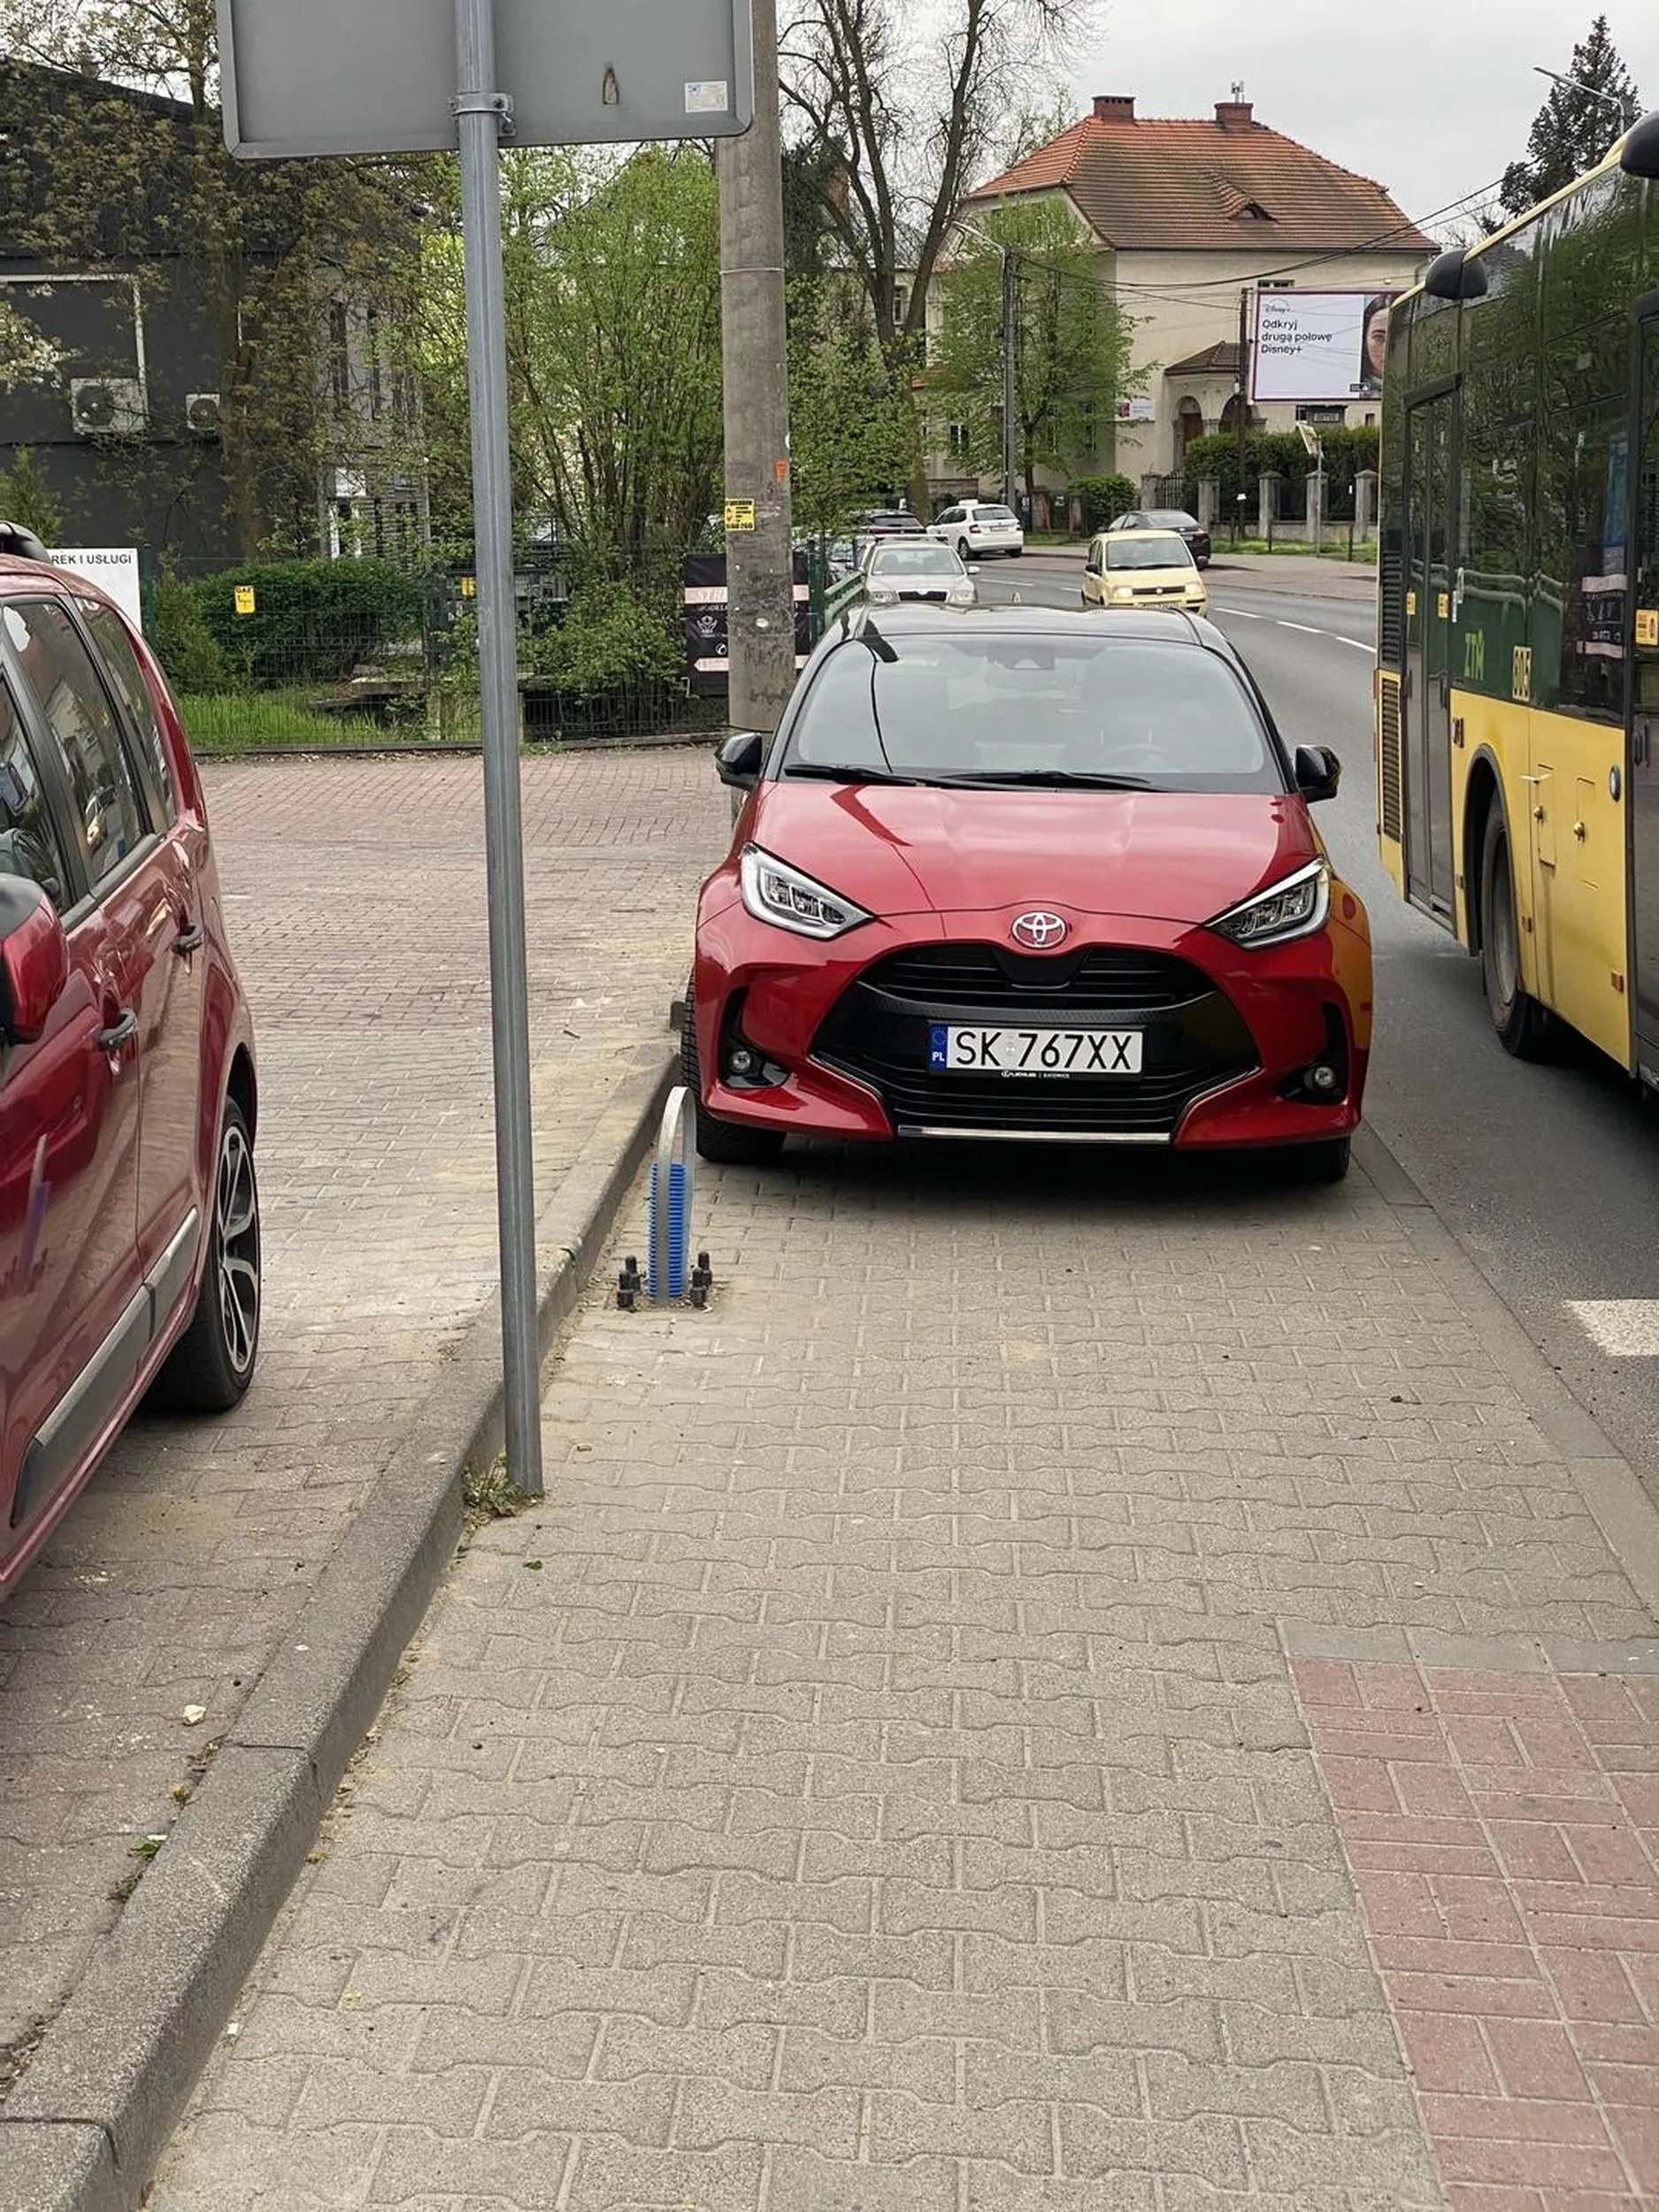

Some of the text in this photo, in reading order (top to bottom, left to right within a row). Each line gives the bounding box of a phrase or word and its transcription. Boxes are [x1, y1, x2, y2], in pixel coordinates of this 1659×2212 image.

[1262, 319, 1298, 330] Odkryj
[1260, 344, 1303, 356] Disney+
[87, 554, 132, 565] USŁUGI
[1463, 626, 1486, 680] ZTM
[932, 1051, 945, 1063] PL
[956, 1031, 1133, 1071] SK 767XX
